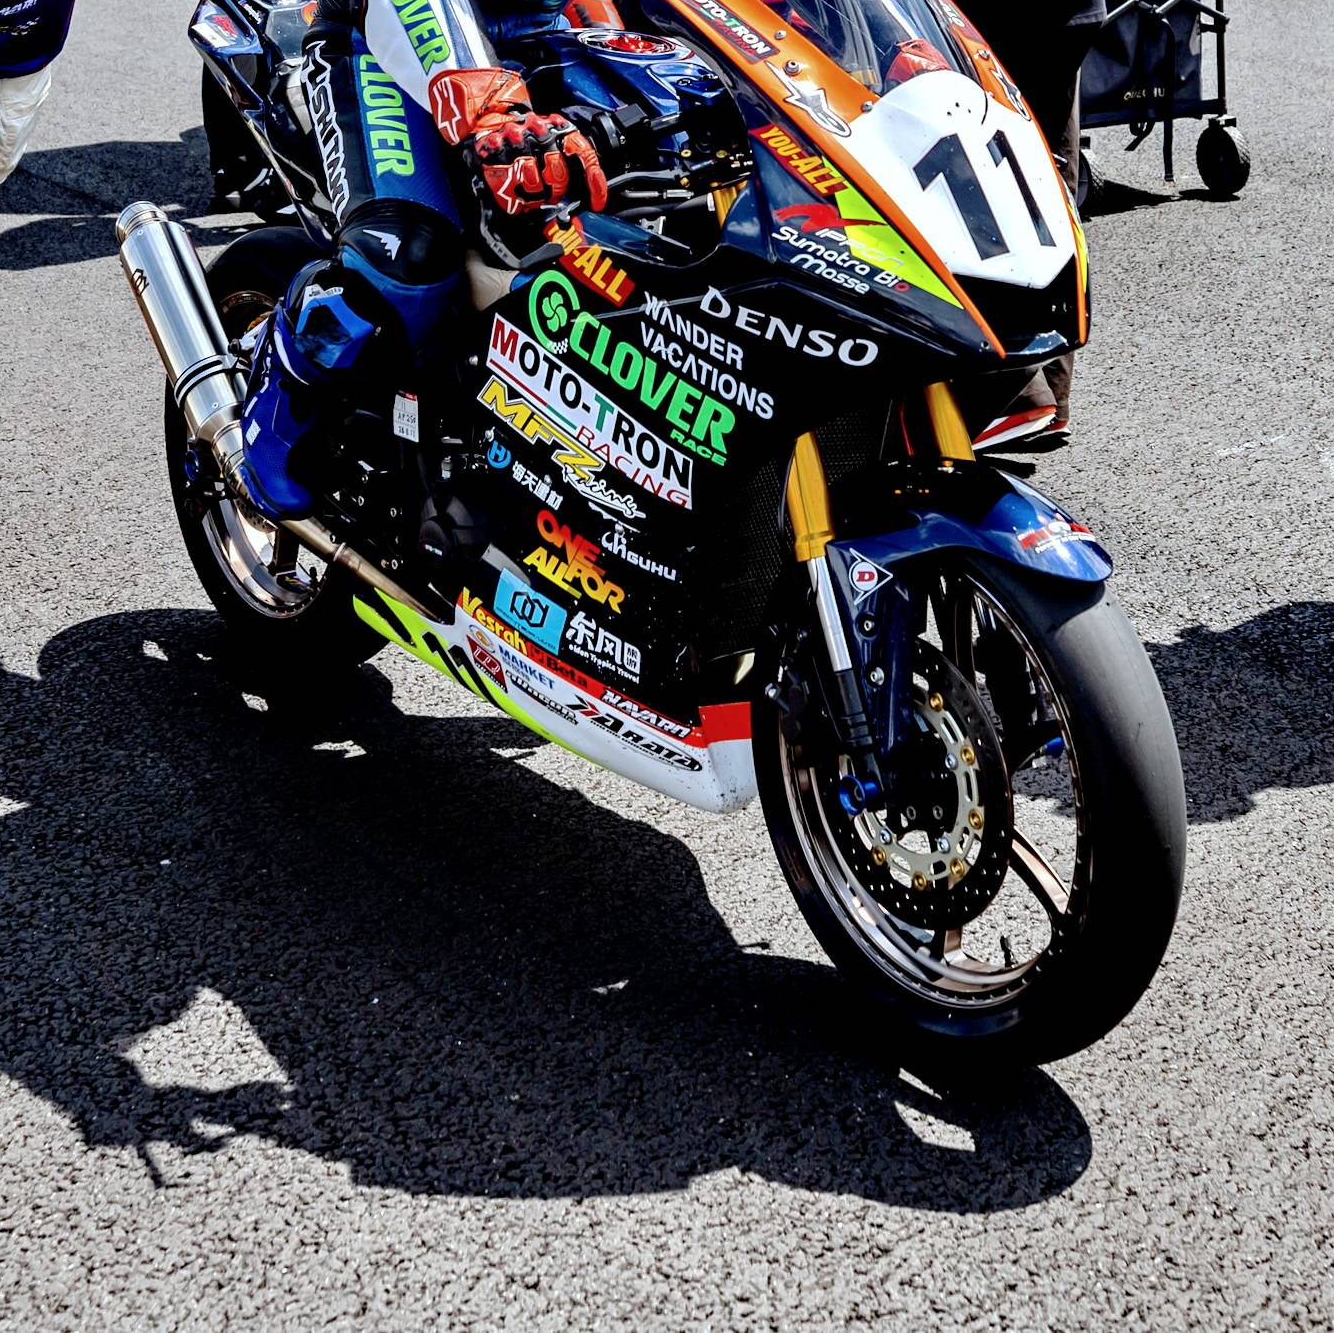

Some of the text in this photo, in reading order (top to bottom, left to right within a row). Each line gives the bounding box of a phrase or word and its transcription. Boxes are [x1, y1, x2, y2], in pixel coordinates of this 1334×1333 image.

[759, 127, 838, 195] YOU-ALL
[913, 129, 1057, 260] 11
[771, 225, 910, 293] Sumatra Bio
[789, 253, 871, 294] Masse
[643, 291, 744, 370] WANDER
[699, 286, 879, 367] DENSO
[492, 318, 691, 490] MOTO-TRON
[569, 311, 736, 454] CLOVER
[639, 321, 775, 420] VACATIONS
[575, 425, 690, 508] RACING
[670, 429, 727, 467] RACE
[461, 586, 528, 656] Vesrah
[498, 644, 555, 691] MARKET
